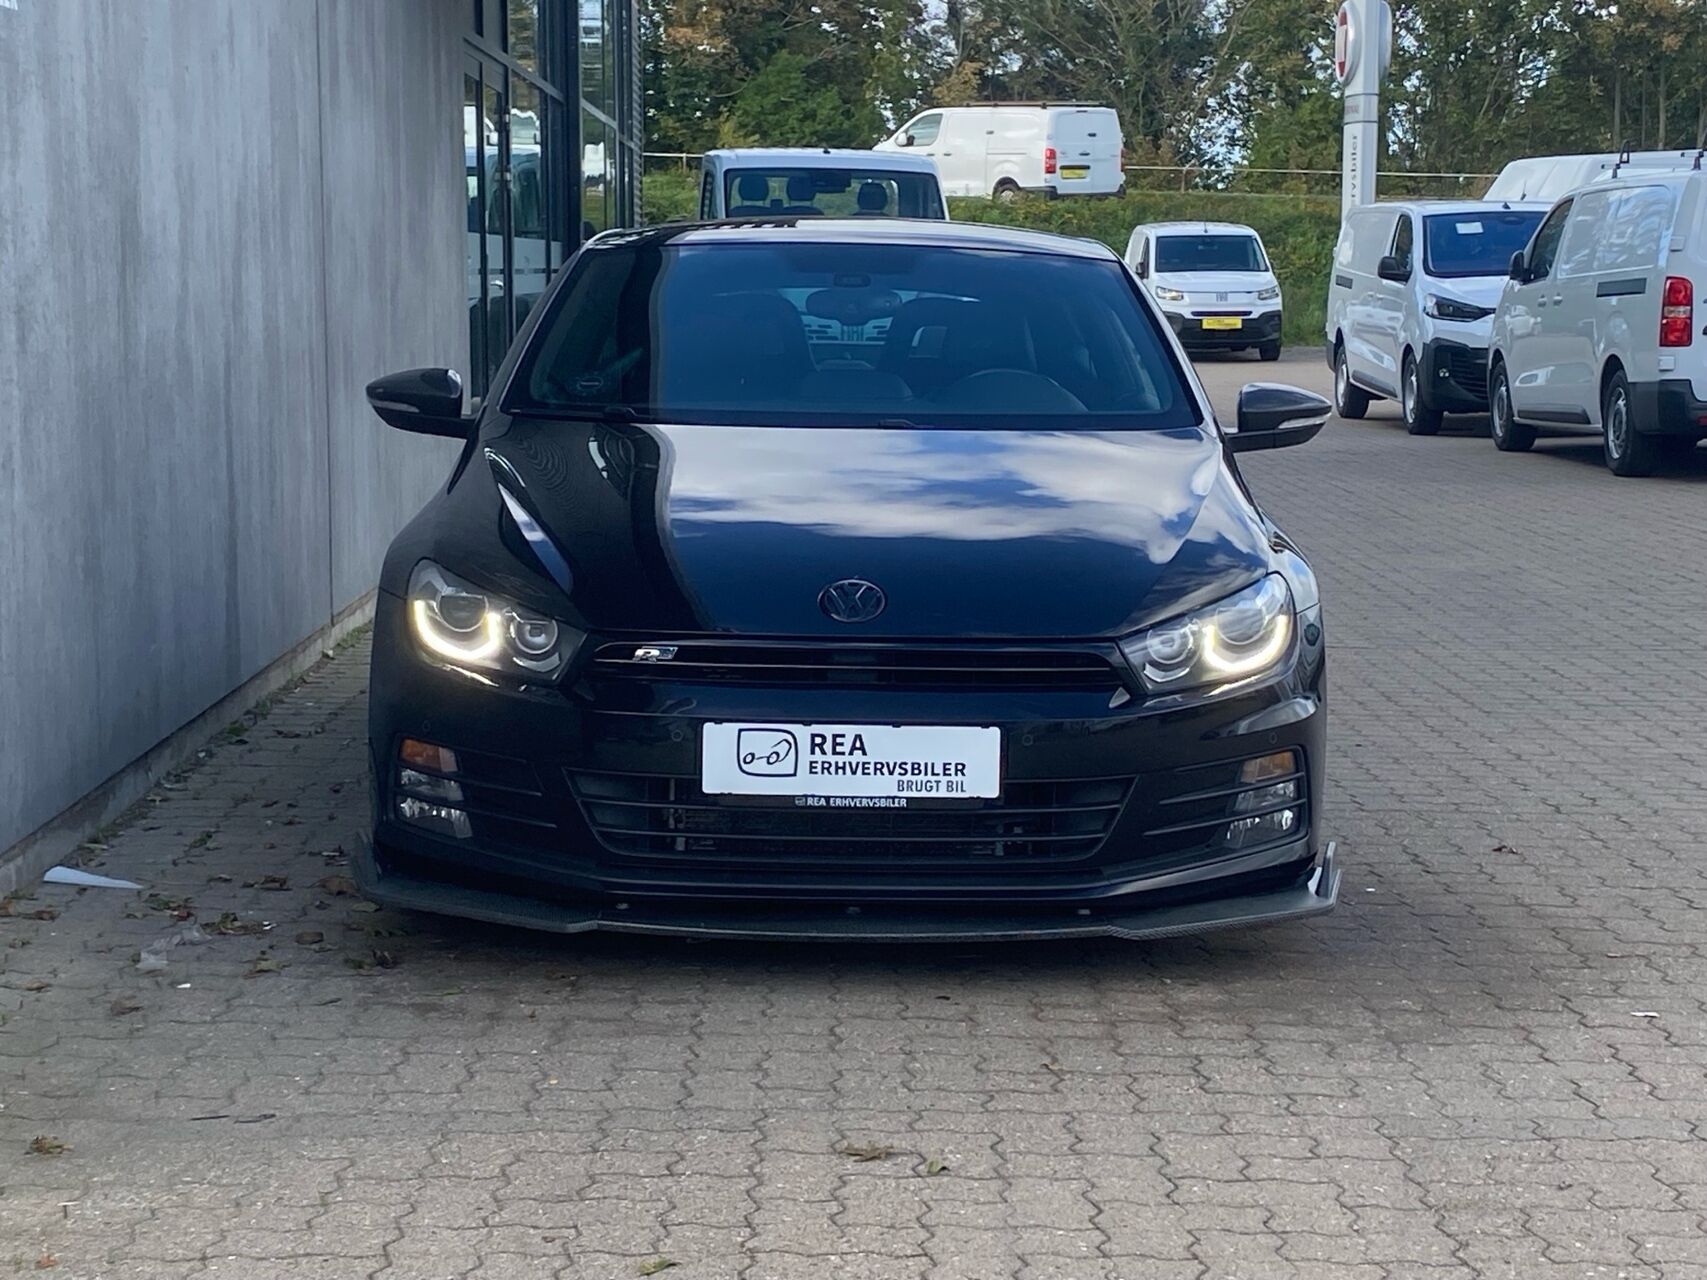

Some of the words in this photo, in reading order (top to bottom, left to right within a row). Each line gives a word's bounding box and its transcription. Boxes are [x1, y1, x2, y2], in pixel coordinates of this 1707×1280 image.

[809, 733, 868, 756] REA
[808, 760, 967, 777] ERHVERVSBILER
[897, 779, 942, 793] BRUGT
[946, 780, 967, 793] BIL
[807, 797, 826, 806] REA
[830, 797, 907, 808] ERHVERVSBILER
